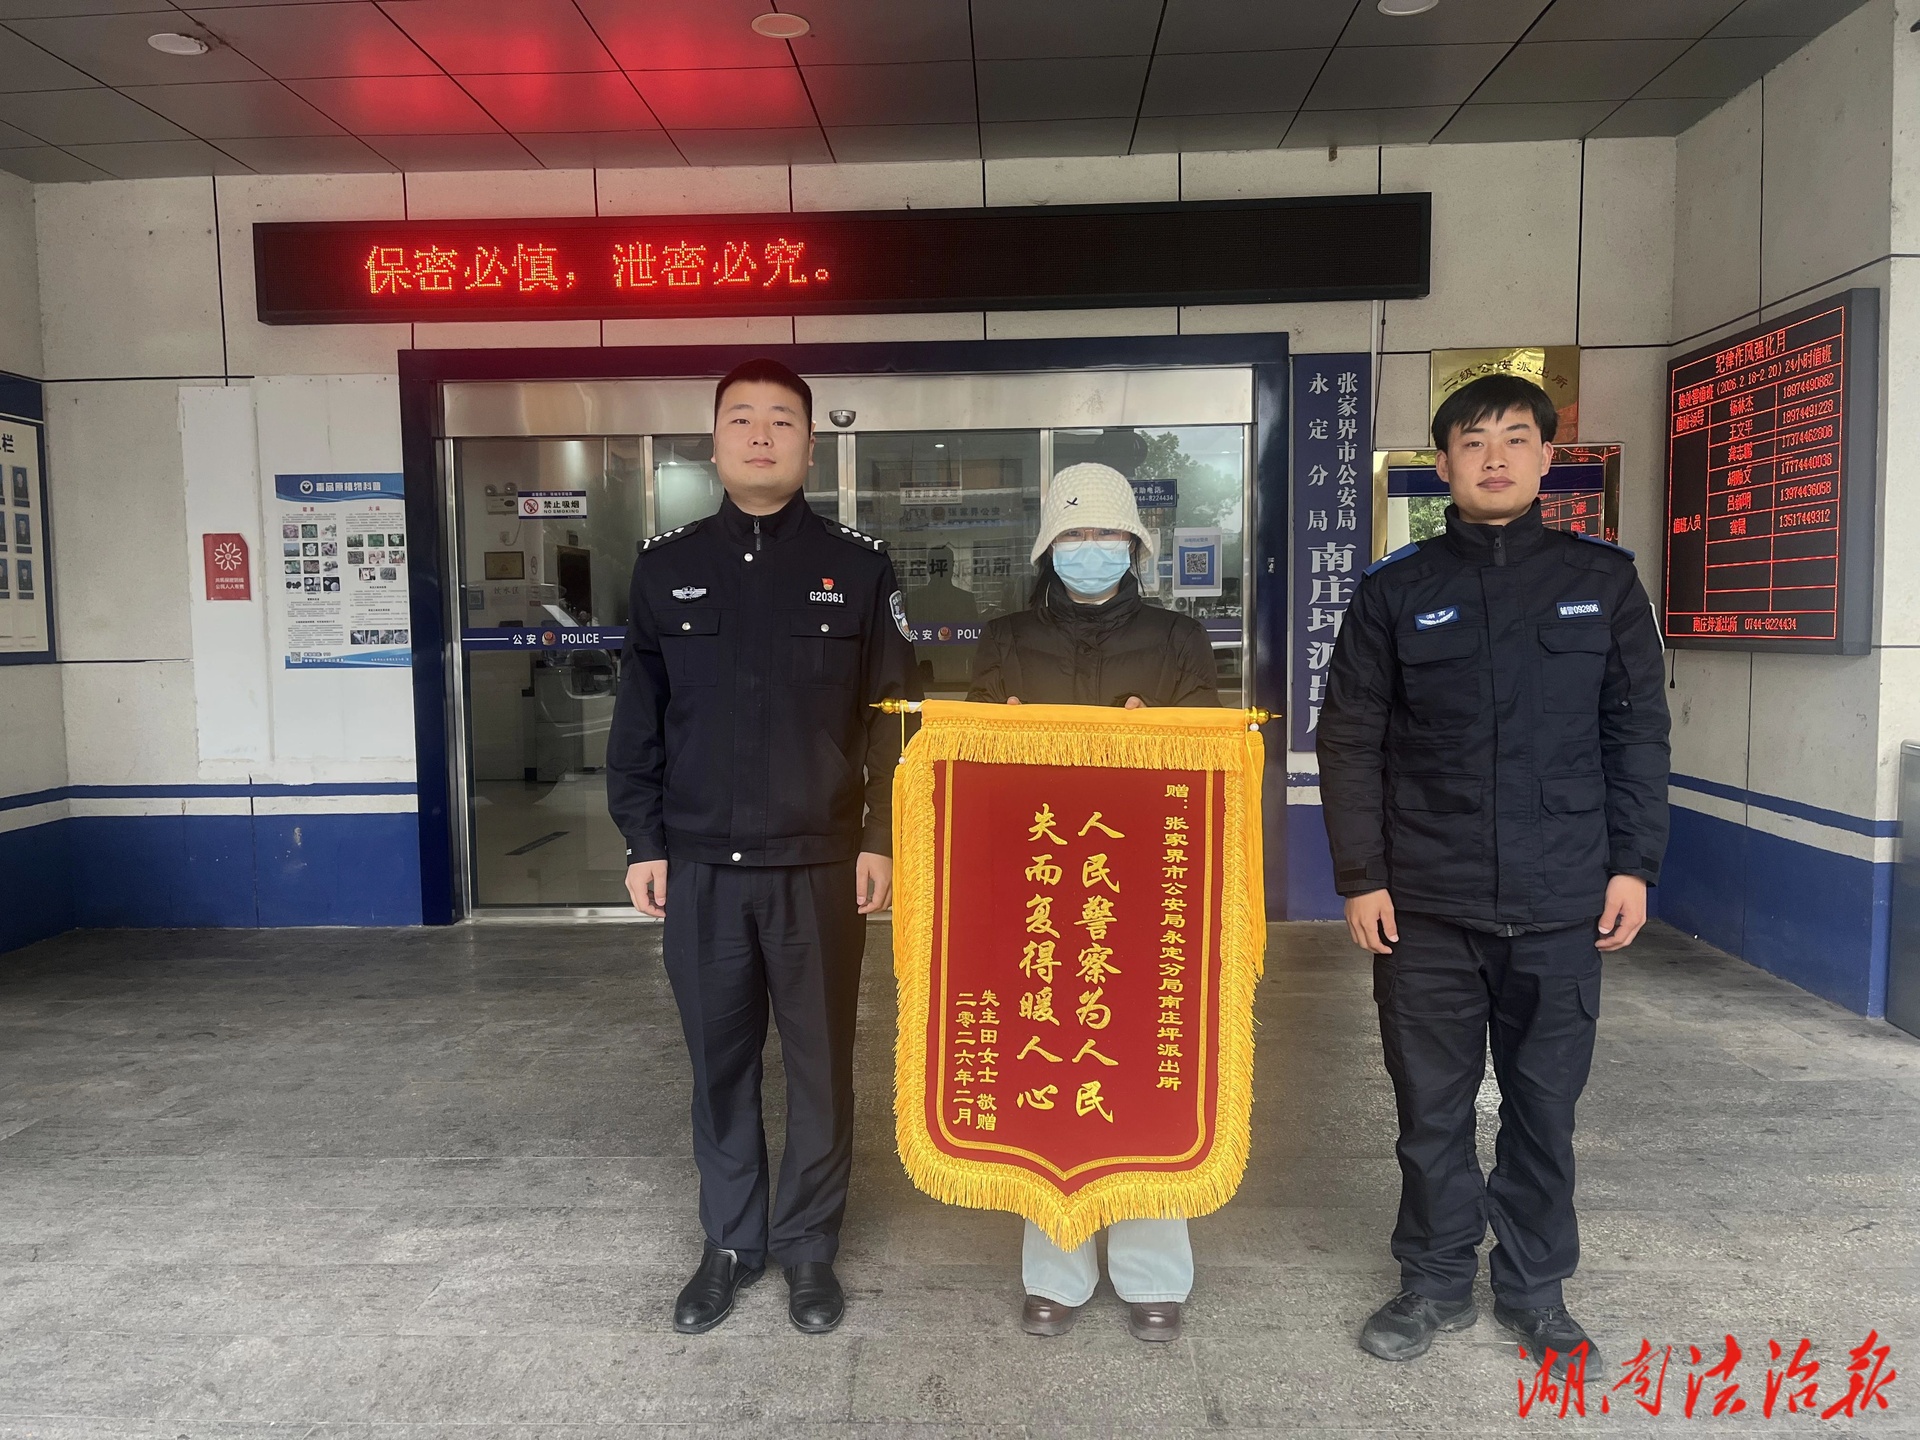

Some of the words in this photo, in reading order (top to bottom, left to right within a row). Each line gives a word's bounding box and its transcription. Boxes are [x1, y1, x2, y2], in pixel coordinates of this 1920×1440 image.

[363, 239, 830, 295] 保密必慎，泄密必究。
[1715, 330, 1787, 374] 纪律作风强化月
[1443, 359, 1568, 392] 二级公安派出所
[1729, 419, 1753, 440] 王文平
[1307, 372, 1330, 532] 永定分局
[1335, 371, 1358, 532] 张家界市公安局
[543, 500, 580, 509] 禁止吸烟
[809, 591, 845, 604] G20361
[512, 633, 537, 645] 公安
[561, 632, 600, 645] POLICE
[1692, 615, 1738, 632] 南庄坪派出所
[1744, 617, 1797, 631] 0744-8224434
[1016, 802, 1068, 1113] 失而复得暖人心
[1071, 811, 1125, 1123] 人民警察为人民
[977, 989, 1001, 1085] 失主田女士
[952, 991, 978, 1127] 二零二六年二月
[975, 1093, 998, 1132] 敬赠
